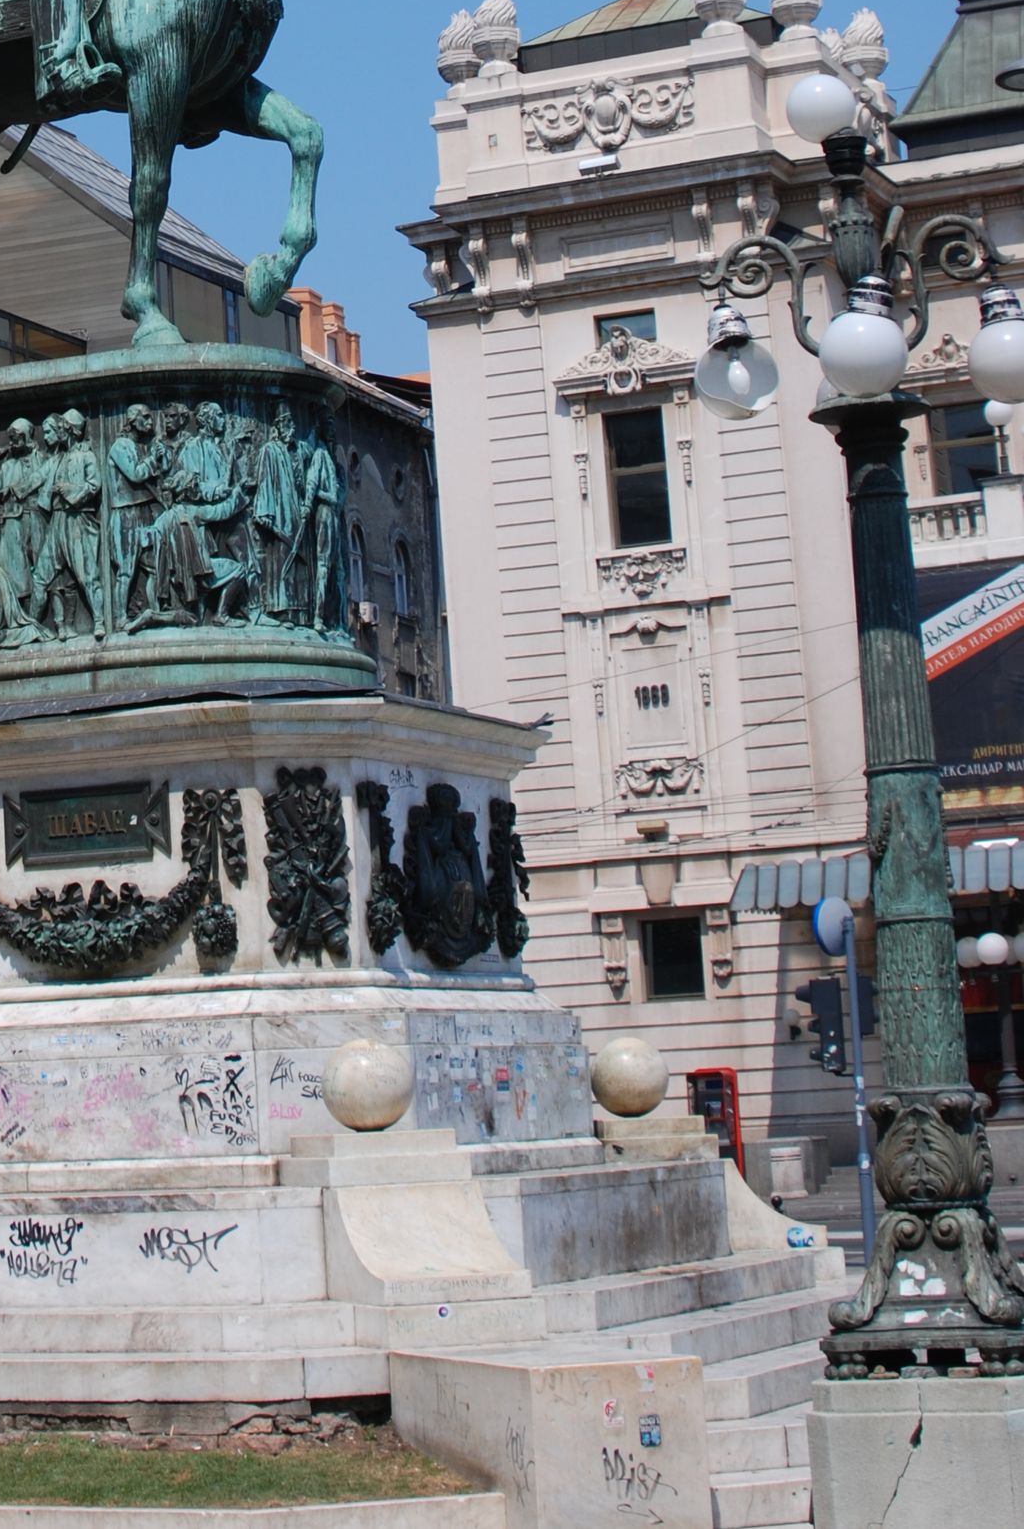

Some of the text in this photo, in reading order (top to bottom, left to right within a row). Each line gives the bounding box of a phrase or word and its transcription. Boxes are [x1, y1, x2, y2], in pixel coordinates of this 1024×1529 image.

[924, 604, 987, 647] BANCA
[926, 645, 968, 675] ЈАТЕЉ
[939, 761, 1004, 778] ЕКСАНДАР
